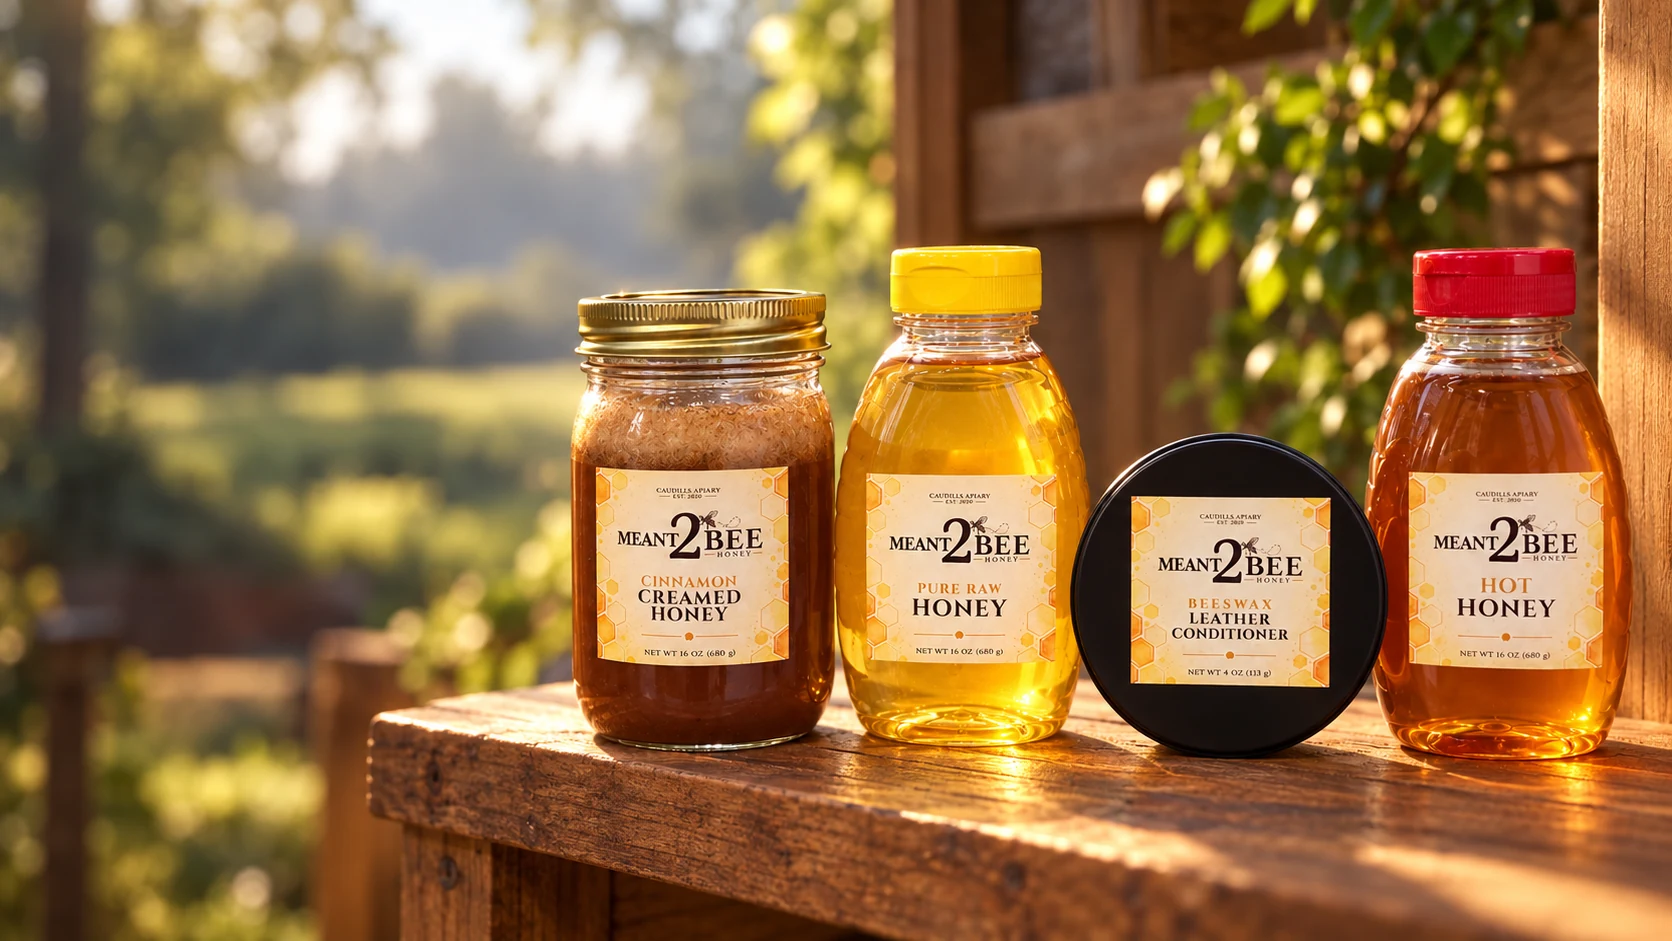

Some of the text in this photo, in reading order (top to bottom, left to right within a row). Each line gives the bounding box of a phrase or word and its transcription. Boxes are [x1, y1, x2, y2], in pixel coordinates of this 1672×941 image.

[618, 512, 763, 559] MEANT 2 BEE
[890, 518, 1030, 563] MEANT 2 BEE
[1434, 516, 1578, 562] MEANT 2 BEE
[1158, 538, 1303, 583] MEANT 2 BEE
[641, 575, 736, 587] CINNAMON
[918, 583, 1001, 594] PURE RAW
[1481, 578, 1532, 593] HOT
[638, 589, 741, 604] CREAMED
[1188, 598, 1272, 610] BEESWAX
[651, 606, 728, 621] HONEY
[912, 598, 1007, 617] HONEY
[1457, 598, 1556, 618] HONEY
[1190, 612, 1270, 625] LEATHER
[1172, 628, 1288, 640] CONDITIONER
[728, 649, 736, 658] g)
